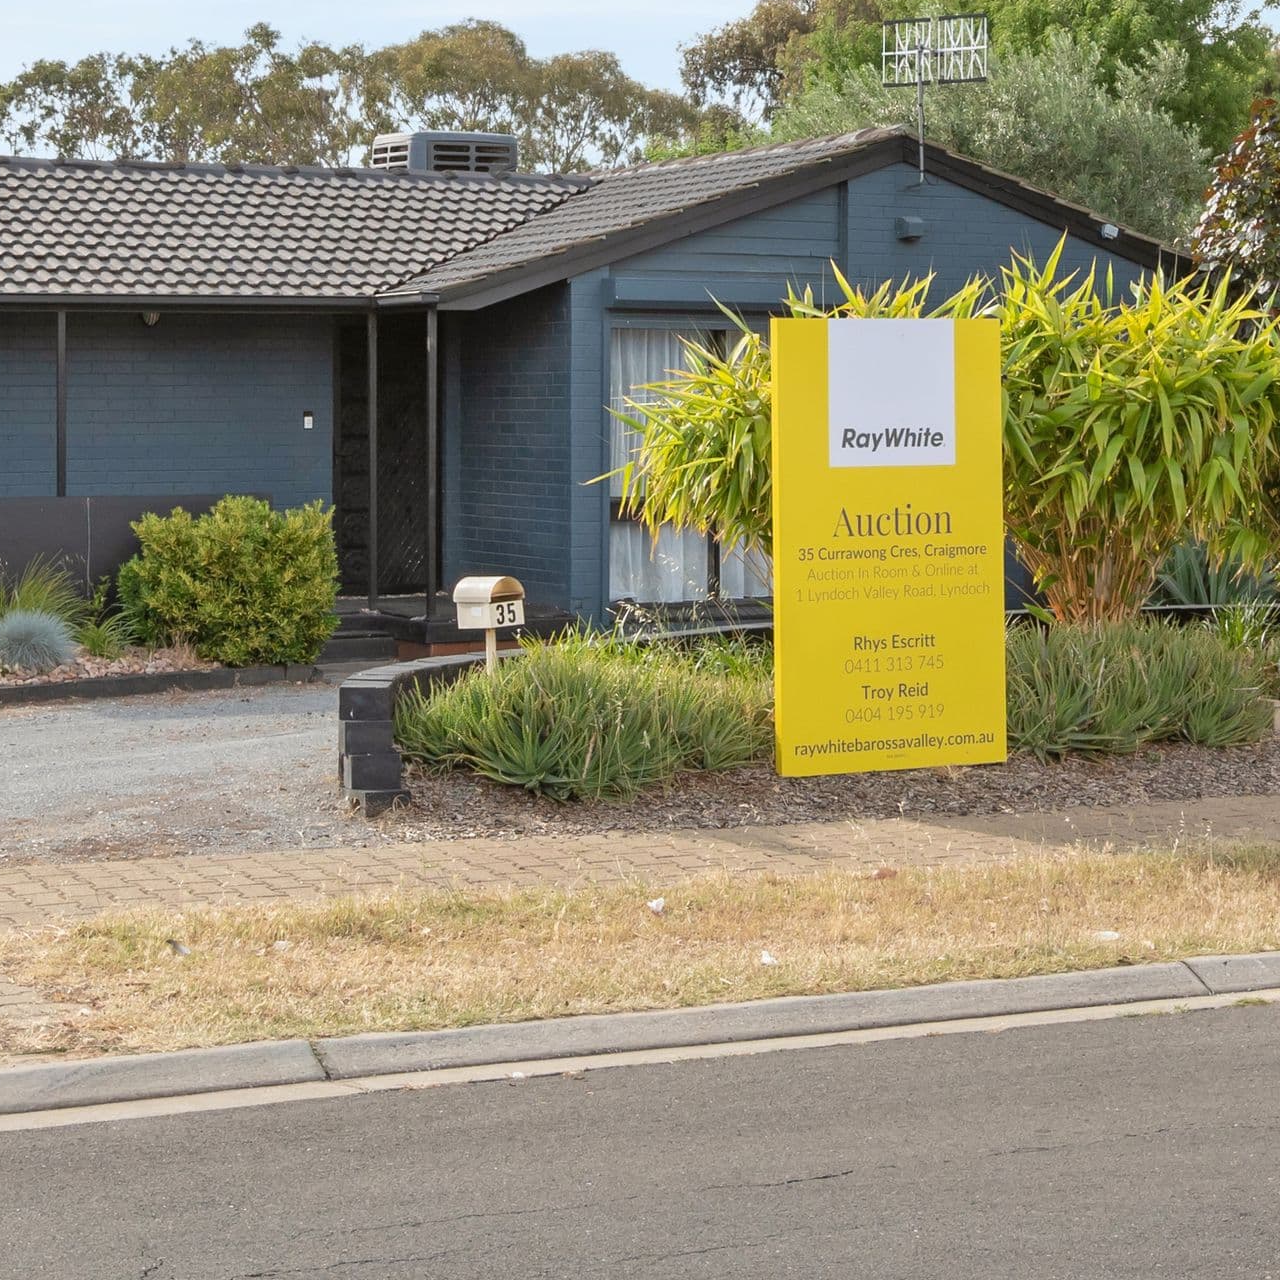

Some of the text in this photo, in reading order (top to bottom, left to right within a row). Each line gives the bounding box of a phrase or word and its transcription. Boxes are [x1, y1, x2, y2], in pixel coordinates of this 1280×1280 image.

[832, 503, 952, 538] Auction
[798, 543, 987, 561] 35 Currawong Cres, Craigmore
[807, 562, 978, 581] Auction In Room & Online at
[795, 589, 803, 602] 1
[808, 586, 860, 604] Lyndoch
[863, 584, 899, 600] Valley
[940, 581, 990, 598] Lyndoch
[496, 602, 516, 625] 35
[853, 633, 936, 653] Rhys Escritt
[844, 654, 945, 674] 0411 313 745
[861, 682, 929, 701] Troy Reid
[845, 703, 945, 724] 0404 195 919
[794, 731, 995, 758] raywhitebarossavalley.com.au
